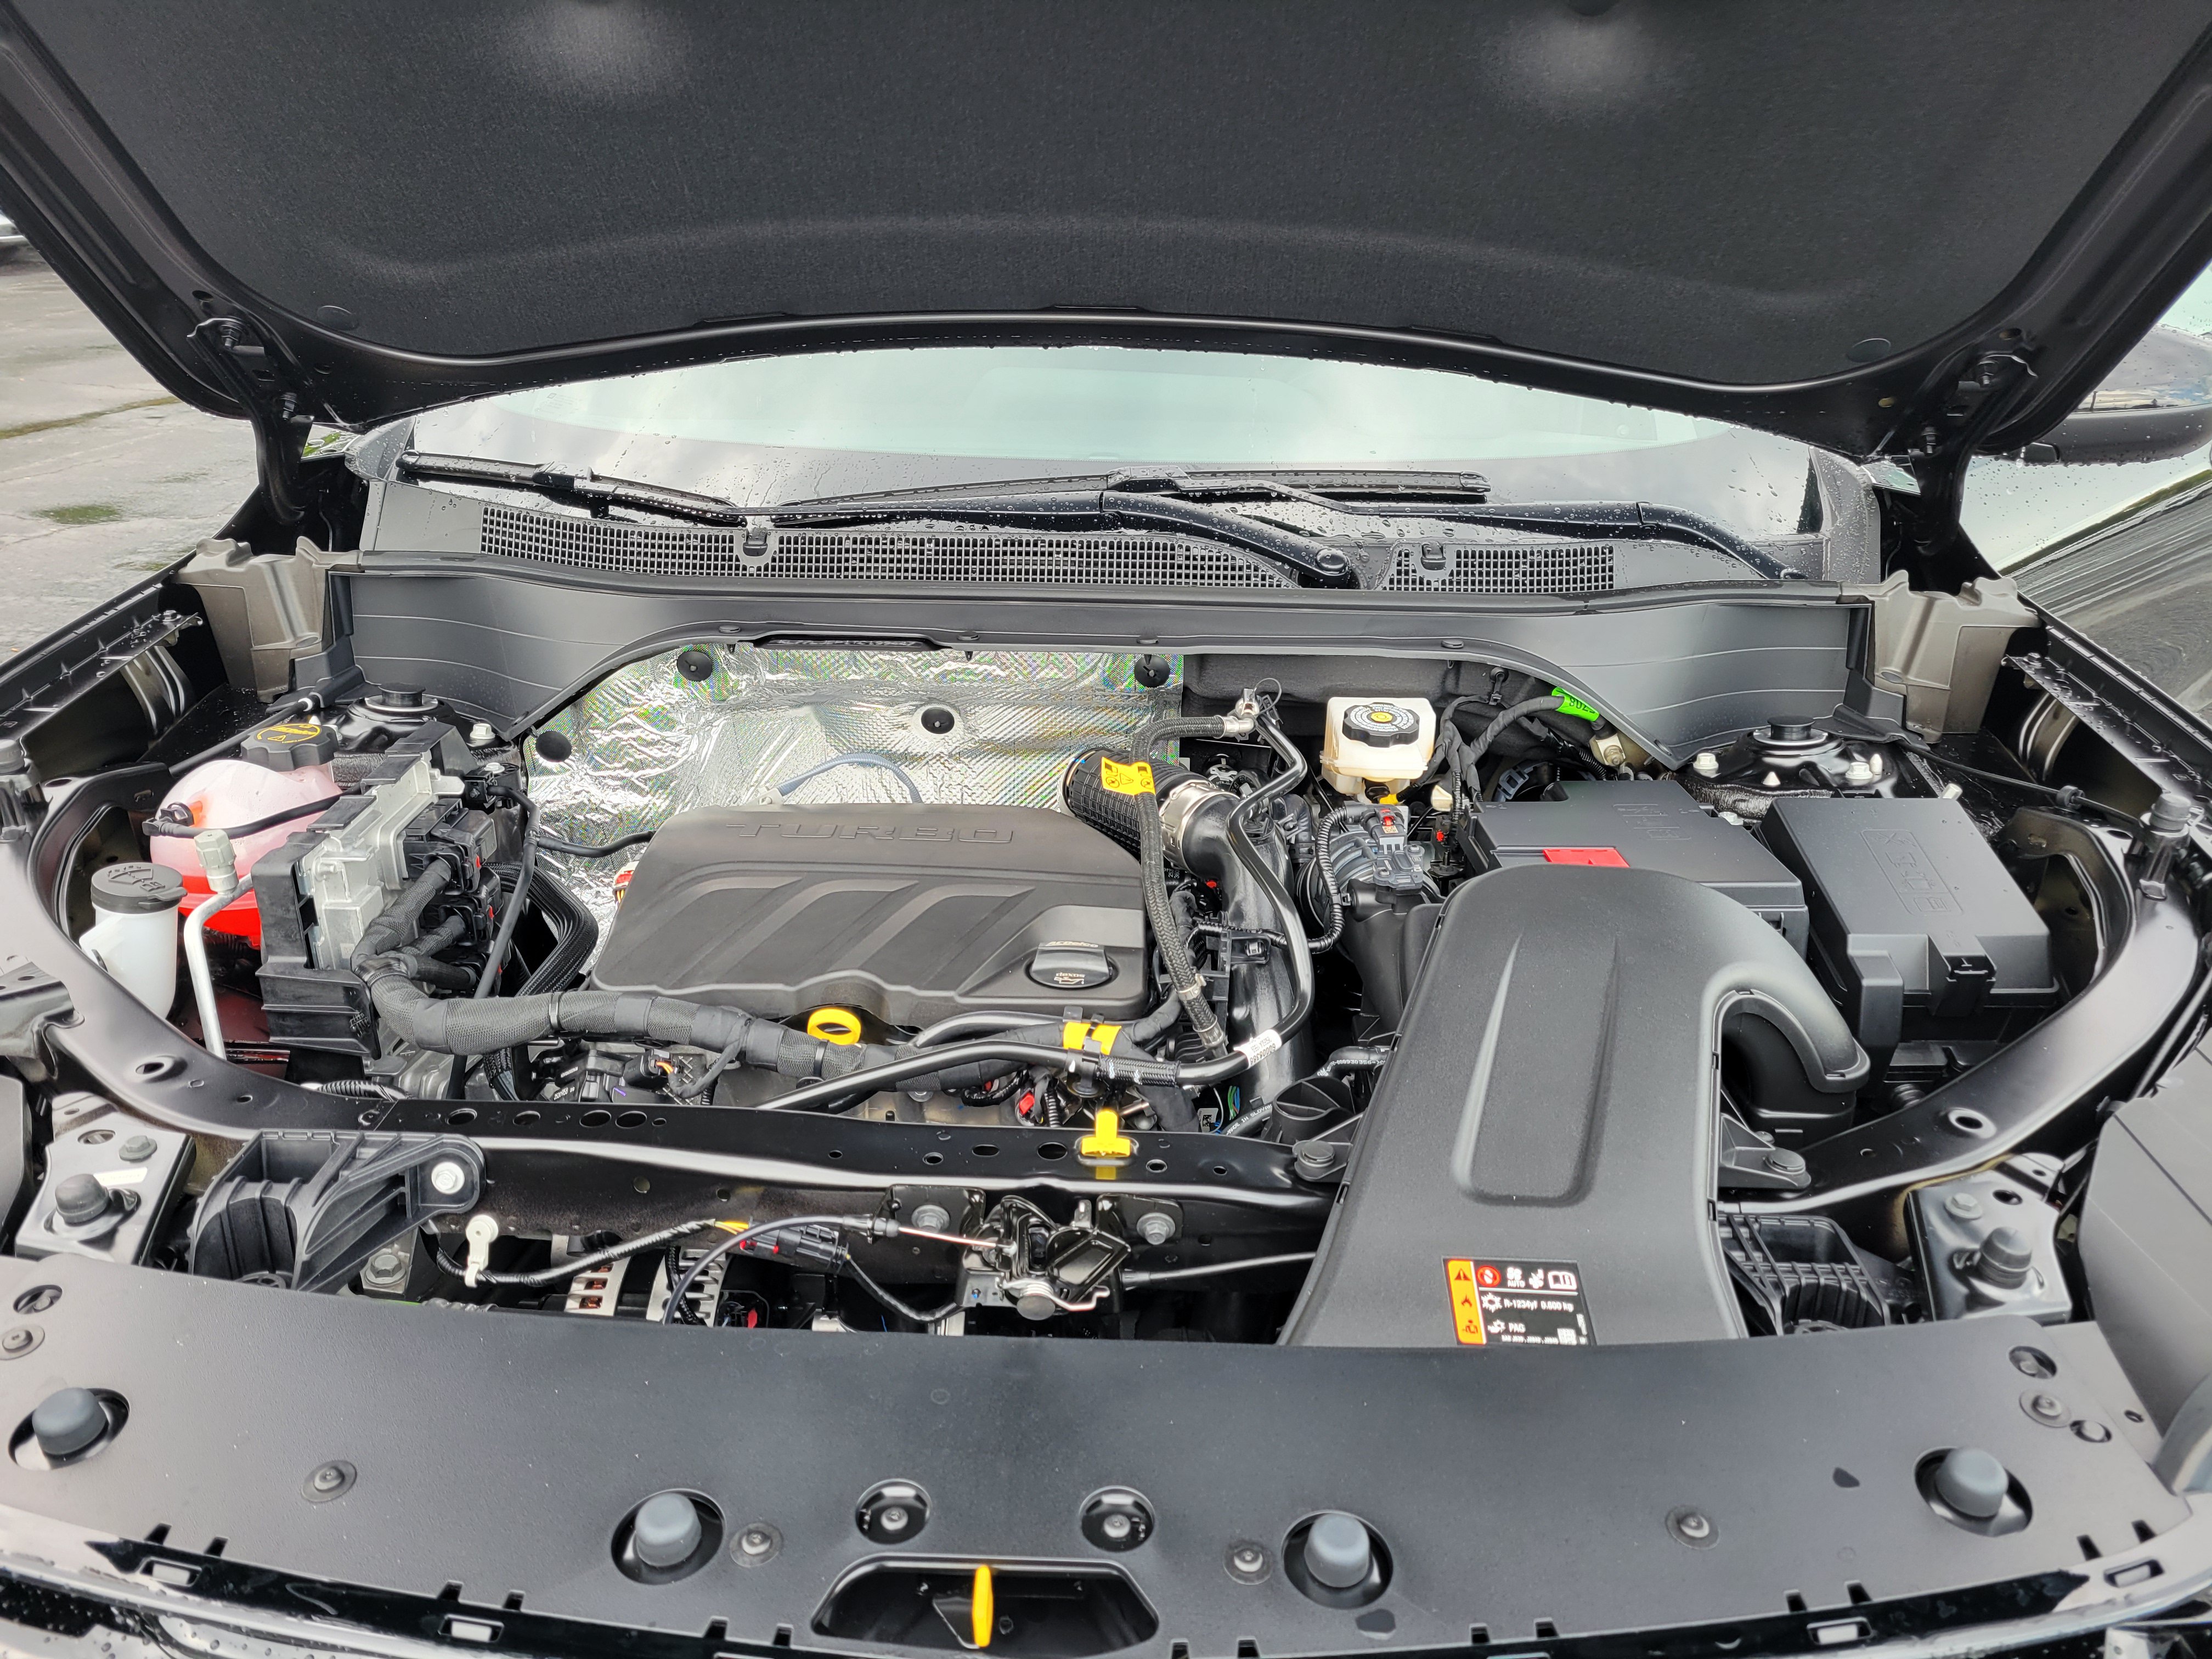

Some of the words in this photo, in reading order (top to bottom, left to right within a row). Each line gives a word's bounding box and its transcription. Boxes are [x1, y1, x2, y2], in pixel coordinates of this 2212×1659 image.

[725, 823, 1014, 843] TURBO
[1507, 1280, 1526, 1288] AUTO
[1509, 1322, 1526, 1333] PAG
